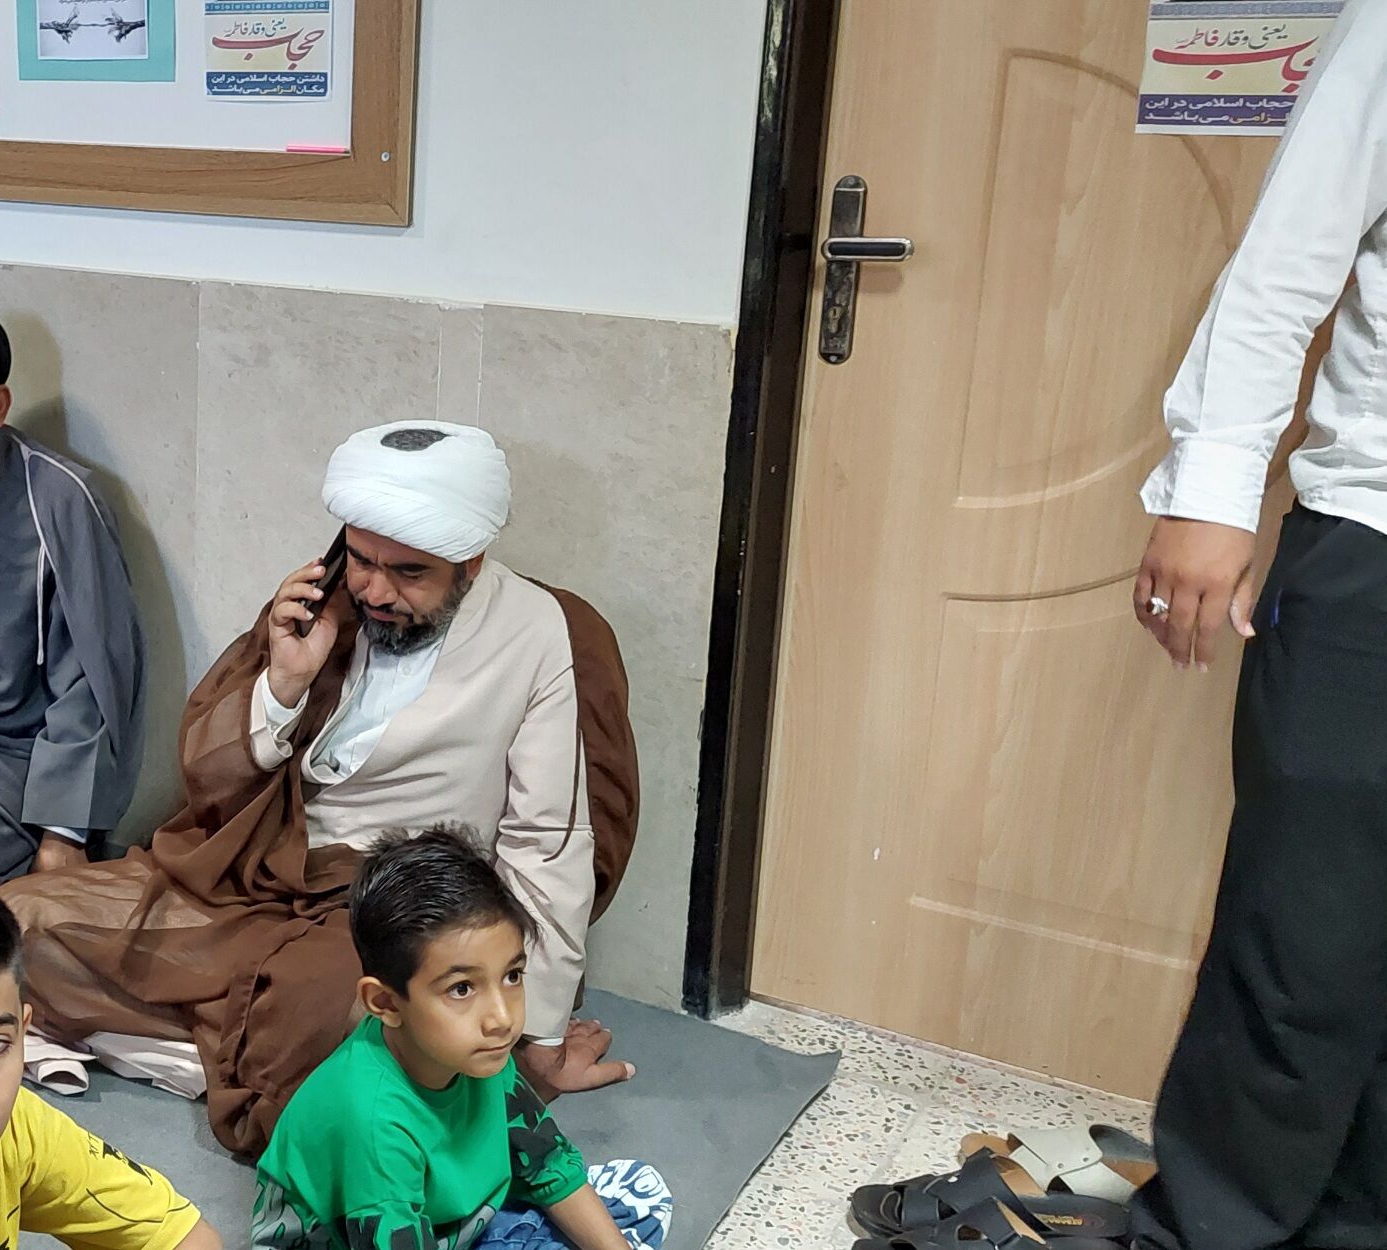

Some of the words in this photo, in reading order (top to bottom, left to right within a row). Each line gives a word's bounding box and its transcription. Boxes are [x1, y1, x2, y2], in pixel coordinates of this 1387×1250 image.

[212, 27, 325, 70] حجاب
[212, 74, 225, 84] این
[226, 75, 235, 84] در
[237, 74, 267, 84] اسلامی
[268, 74, 296, 84] حجاب
[296, 84, 325, 94] مکان
[1145, 97, 1169, 109] این
[1170, 98, 1187, 109] در
[1188, 98, 1243, 109] اسلامی
[1229, 112, 1289, 124] لزامی
